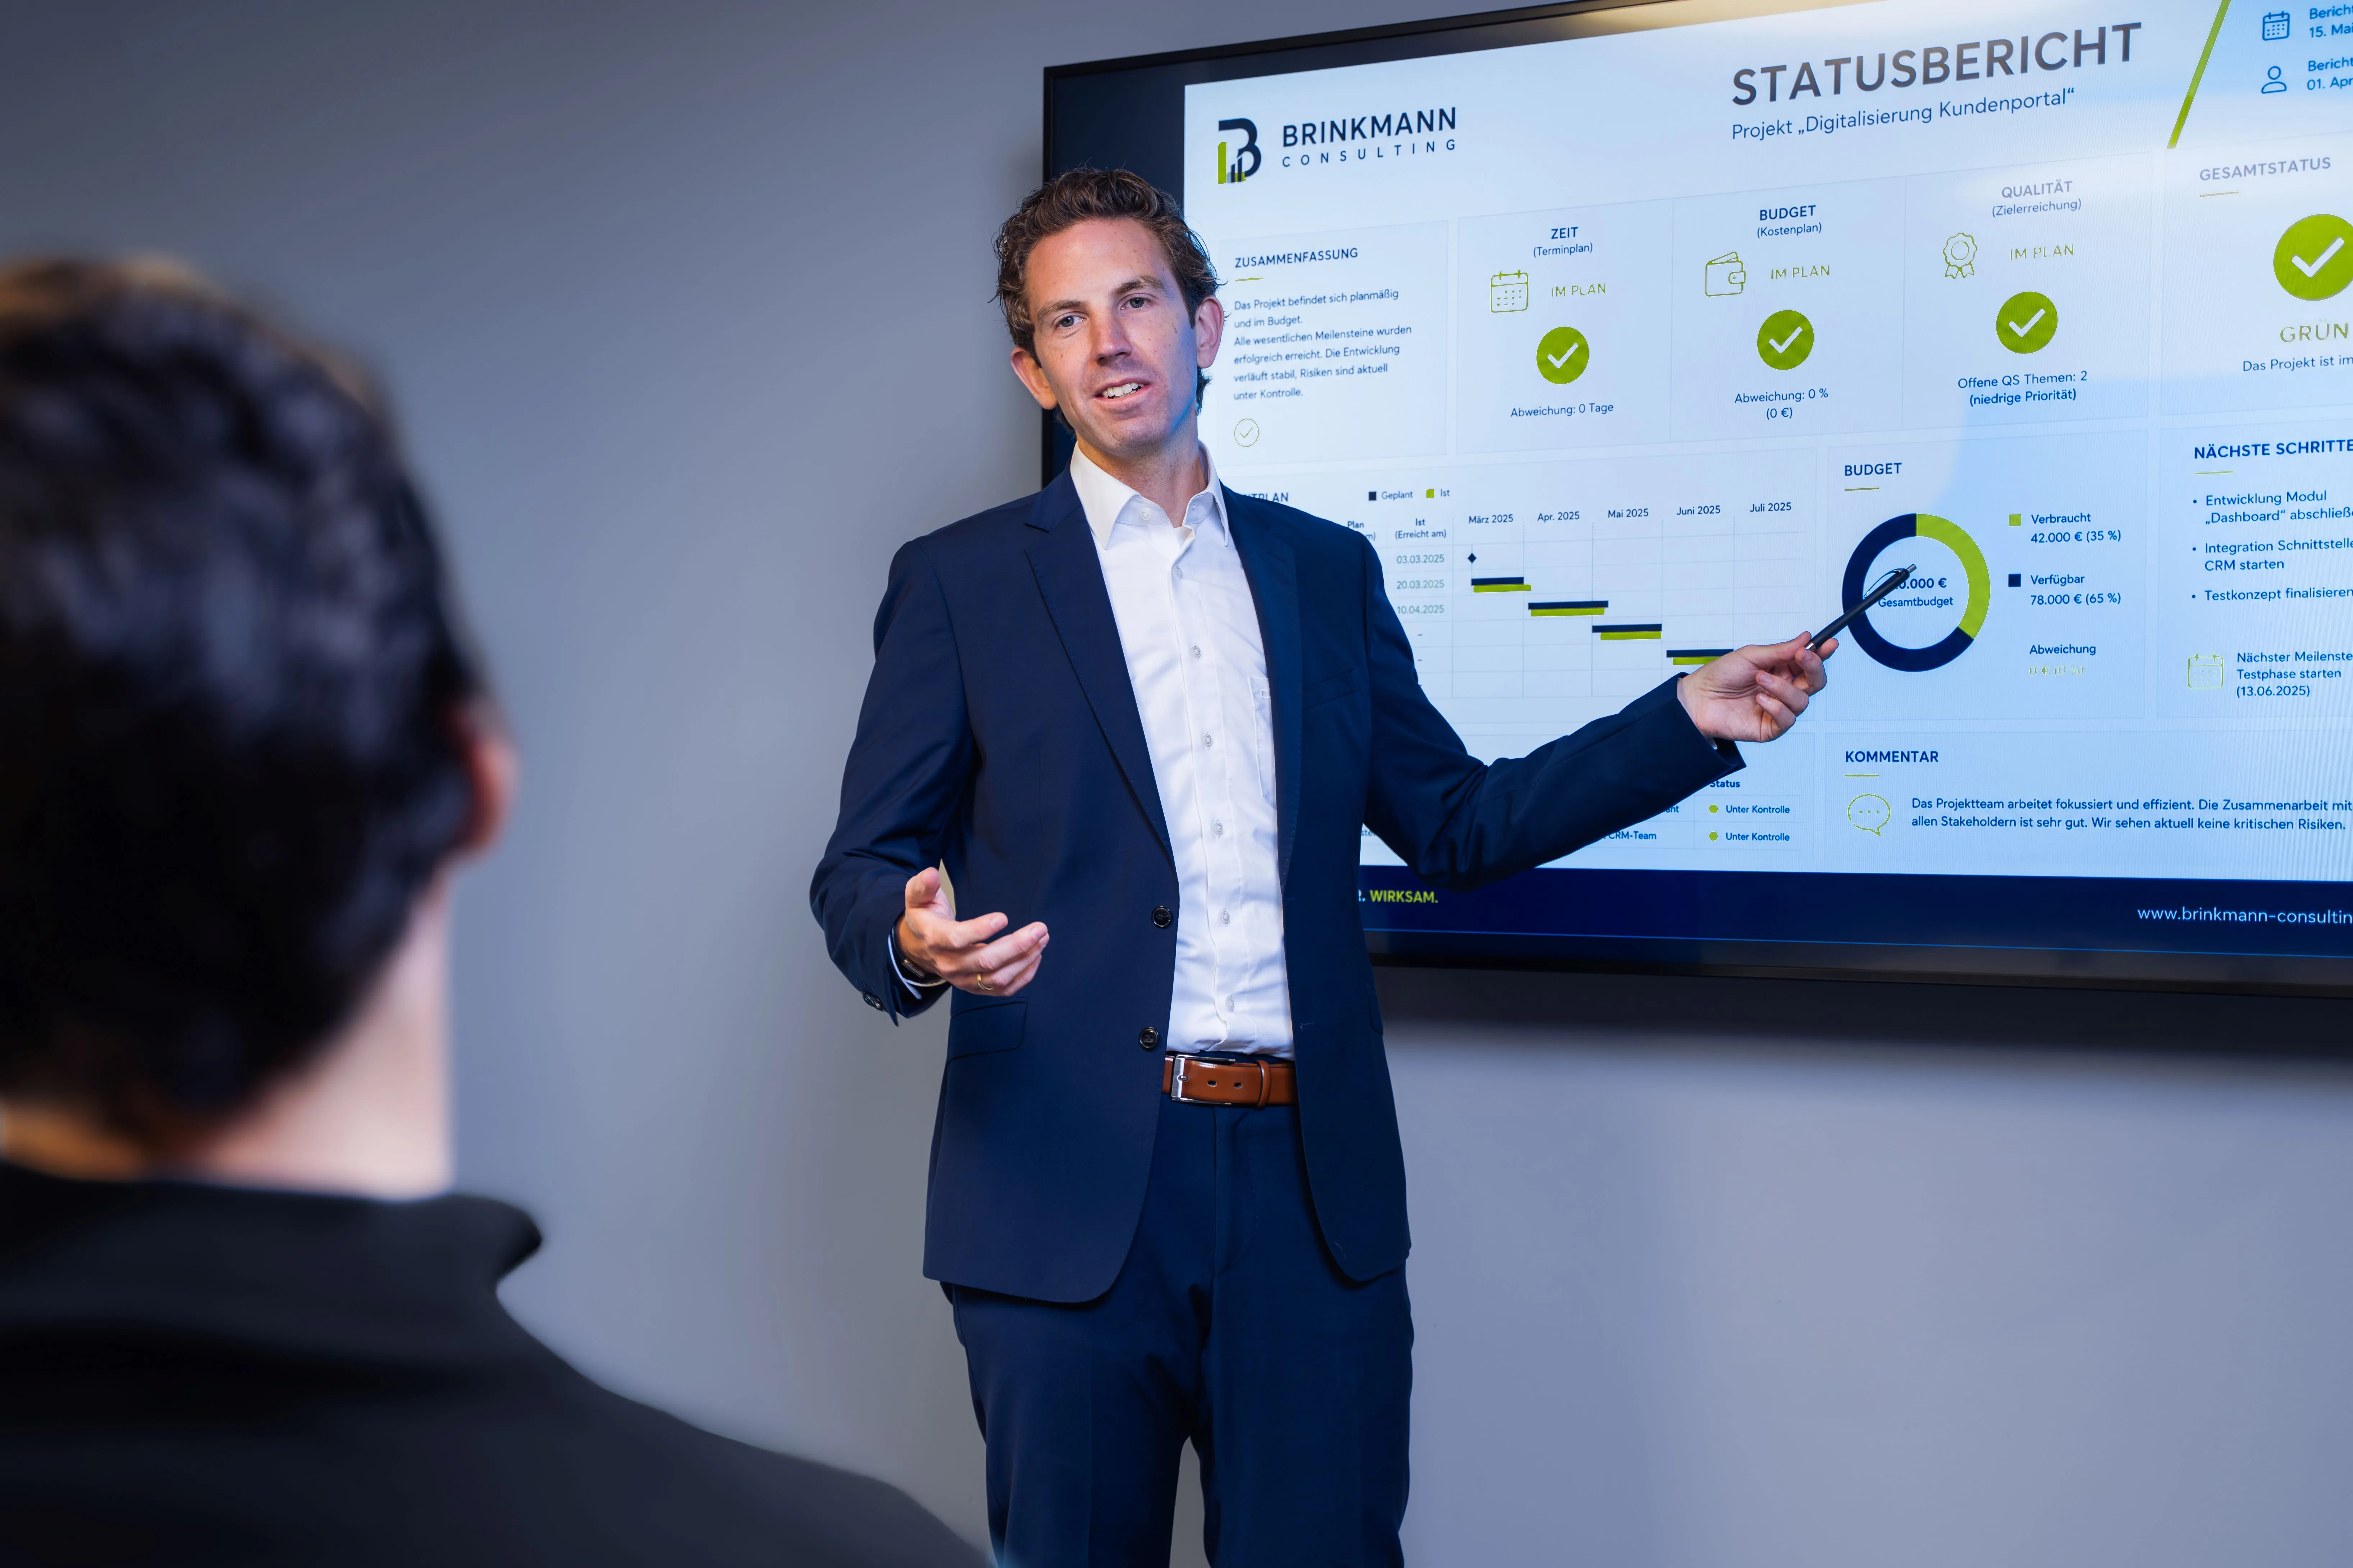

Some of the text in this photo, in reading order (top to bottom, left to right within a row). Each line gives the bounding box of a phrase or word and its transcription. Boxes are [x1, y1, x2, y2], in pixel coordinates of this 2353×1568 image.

[2310, 4, 2353, 19] Berich
[2309, 26, 2326, 38] 15.
[1731, 21, 2142, 106] STATUSBERICHT
[2307, 79, 2325, 90] 01.
[1733, 87, 2074, 141] Projekt „Digitalisierung Kundenportal“
[1282, 107, 1456, 148] BRINKMANN
[1282, 139, 1456, 168] CONSULTING
[2200, 157, 2331, 180] GESAMTSTATUS
[2002, 179, 2072, 198] QUALITÄT
[1760, 205, 1816, 220] BUDGET
[1992, 198, 2081, 218] (Zielerreichung)
[1551, 227, 1578, 239] ZEIT
[1757, 222, 1822, 238] (Kostenplan)
[1534, 242, 1593, 257] (Terminplan)
[2011, 244, 2073, 260] IM PLAN
[1235, 248, 1358, 268] ZUSAMMENFASSUNG
[1771, 265, 1829, 279] IM PLAN
[1552, 283, 1605, 297] IM PLAN
[1235, 289, 1398, 310] Das Projekt befindet sich planmäßig
[1235, 319, 1251, 328] und
[1268, 316, 1302, 326] Budget.
[1234, 325, 1411, 346] Alle wesentlichen Meilensteine wurden
[2279, 319, 2349, 343] GRÜN
[1234, 345, 1399, 365] erfolgreich erreicht. Die Entwicklung
[2243, 361, 2266, 371] Das
[2271, 357, 2315, 371] Projekt
[2320, 356, 2334, 366] ist
[1234, 364, 1388, 381] verläuft stabil, Risiken sind aktuell
[1958, 371, 2087, 388] Offene QS Themen: 2
[1261, 388, 1303, 398] Kontrolle.
[1735, 388, 1828, 403] Abweichung: 0 %
[1970, 388, 2076, 407] (niedrige Priorität)
[1511, 403, 1613, 417] Abweichung: 0 Tage
[2195, 439, 2353, 459] NÄCHSTE SCHRITTE
[1845, 463, 1902, 476] BUDGET
[1381, 491, 1412, 500] Geplant
[2206, 490, 2326, 506] Entwicklung Modul
[1626, 508, 1648, 517] 2025
[1677, 505, 1720, 515] Juni 2025
[1750, 502, 1791, 512] Juli 2025
[1492, 514, 1513, 523] 2025
[1538, 511, 1580, 522] Apr. 2025
[2031, 513, 2091, 524] Verbraucht
[2206, 507, 2353, 524] „Dashboard“ abschließ
[1395, 529, 1446, 540] (Erreicht am)
[2031, 532, 2070, 543] 42.000
[2074, 531, 2082, 541] €
[2087, 531, 2104, 543] (35
[2206, 541, 2273, 555] Integration
[1397, 554, 1444, 564] 03.03.2025
[2205, 559, 2284, 571] CRM starten
[1397, 580, 1444, 589] 20.03.2025
[1938, 578, 1947, 588] €
[2030, 574, 2084, 586] Verfügbar
[2030, 594, 2070, 605] 78.000
[2074, 594, 2082, 604] €
[2086, 593, 2103, 605] (65
[2204, 587, 2353, 601] Testkonzept finalisieren
[1878, 596, 1954, 608] Gesamtbudget
[1397, 605, 1444, 614] 10.04.2025
[2030, 644, 2096, 655] Abweichung
[2237, 652, 2290, 662] Nächster
[2237, 669, 2341, 681] Testphase starten
[2237, 685, 2310, 698] (13.06.2025)
[1846, 751, 1938, 762] KOMMENTAR
[1913, 798, 2352, 811] Das Projektteam arbeitet fokussiert und effizient. Die Zusammenarbeit mit
[1912, 816, 2345, 830] allen Stakeholdern ist sehr gut. Wir sehen aktuell keine kritischen Risiken.
[1752, 833, 1790, 841] Kontrolle
[1370, 890, 1438, 903] WIRKSAM.
